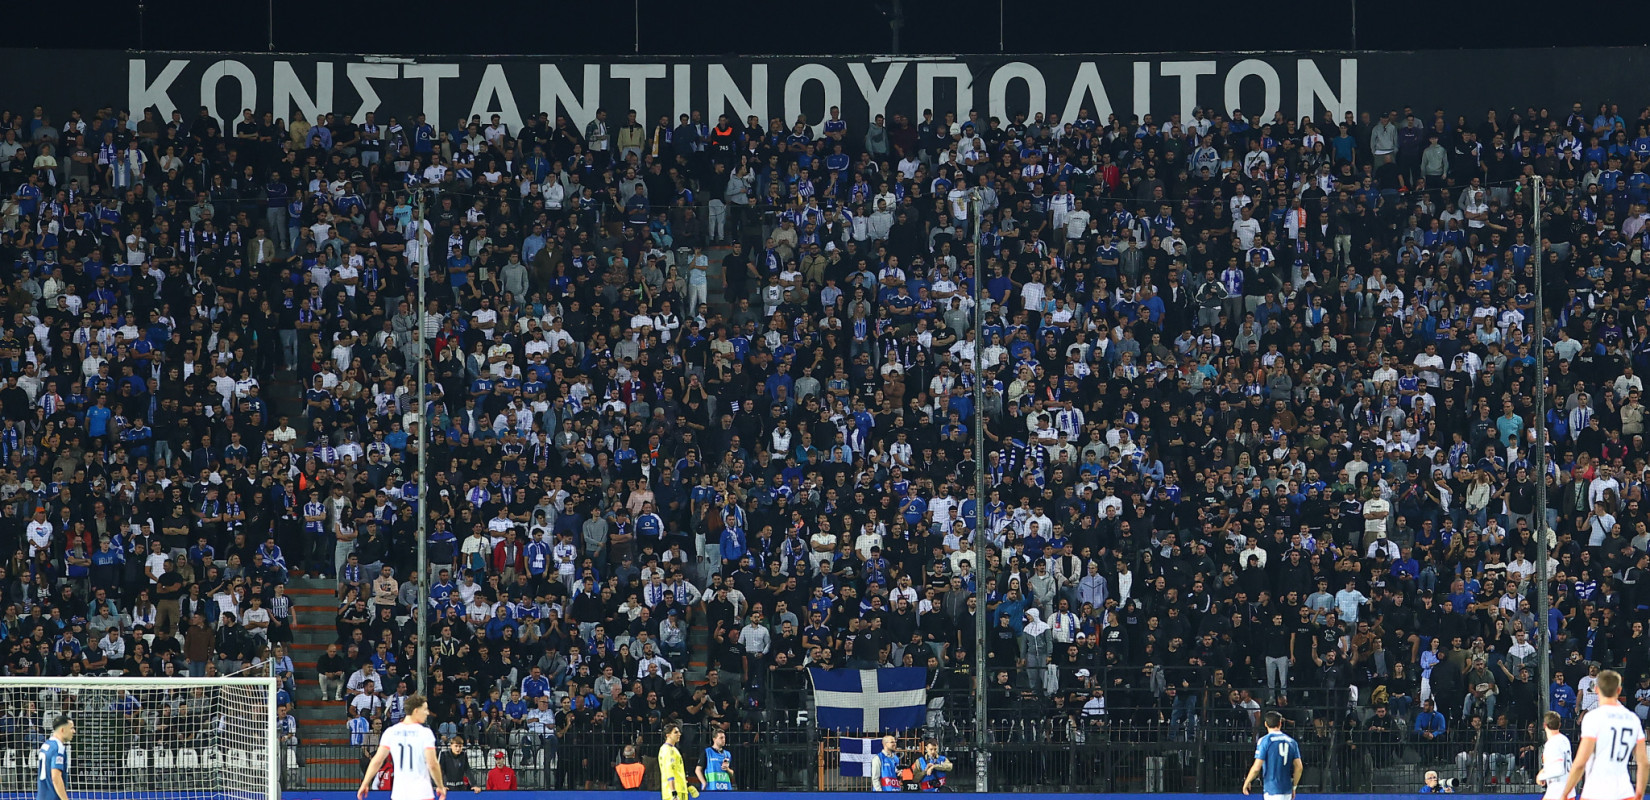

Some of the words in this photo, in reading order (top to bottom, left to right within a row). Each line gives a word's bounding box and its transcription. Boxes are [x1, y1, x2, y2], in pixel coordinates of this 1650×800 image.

[398, 743, 413, 772] 11
[1278, 742, 1290, 766] 4
[1610, 727, 1633, 762] 15
